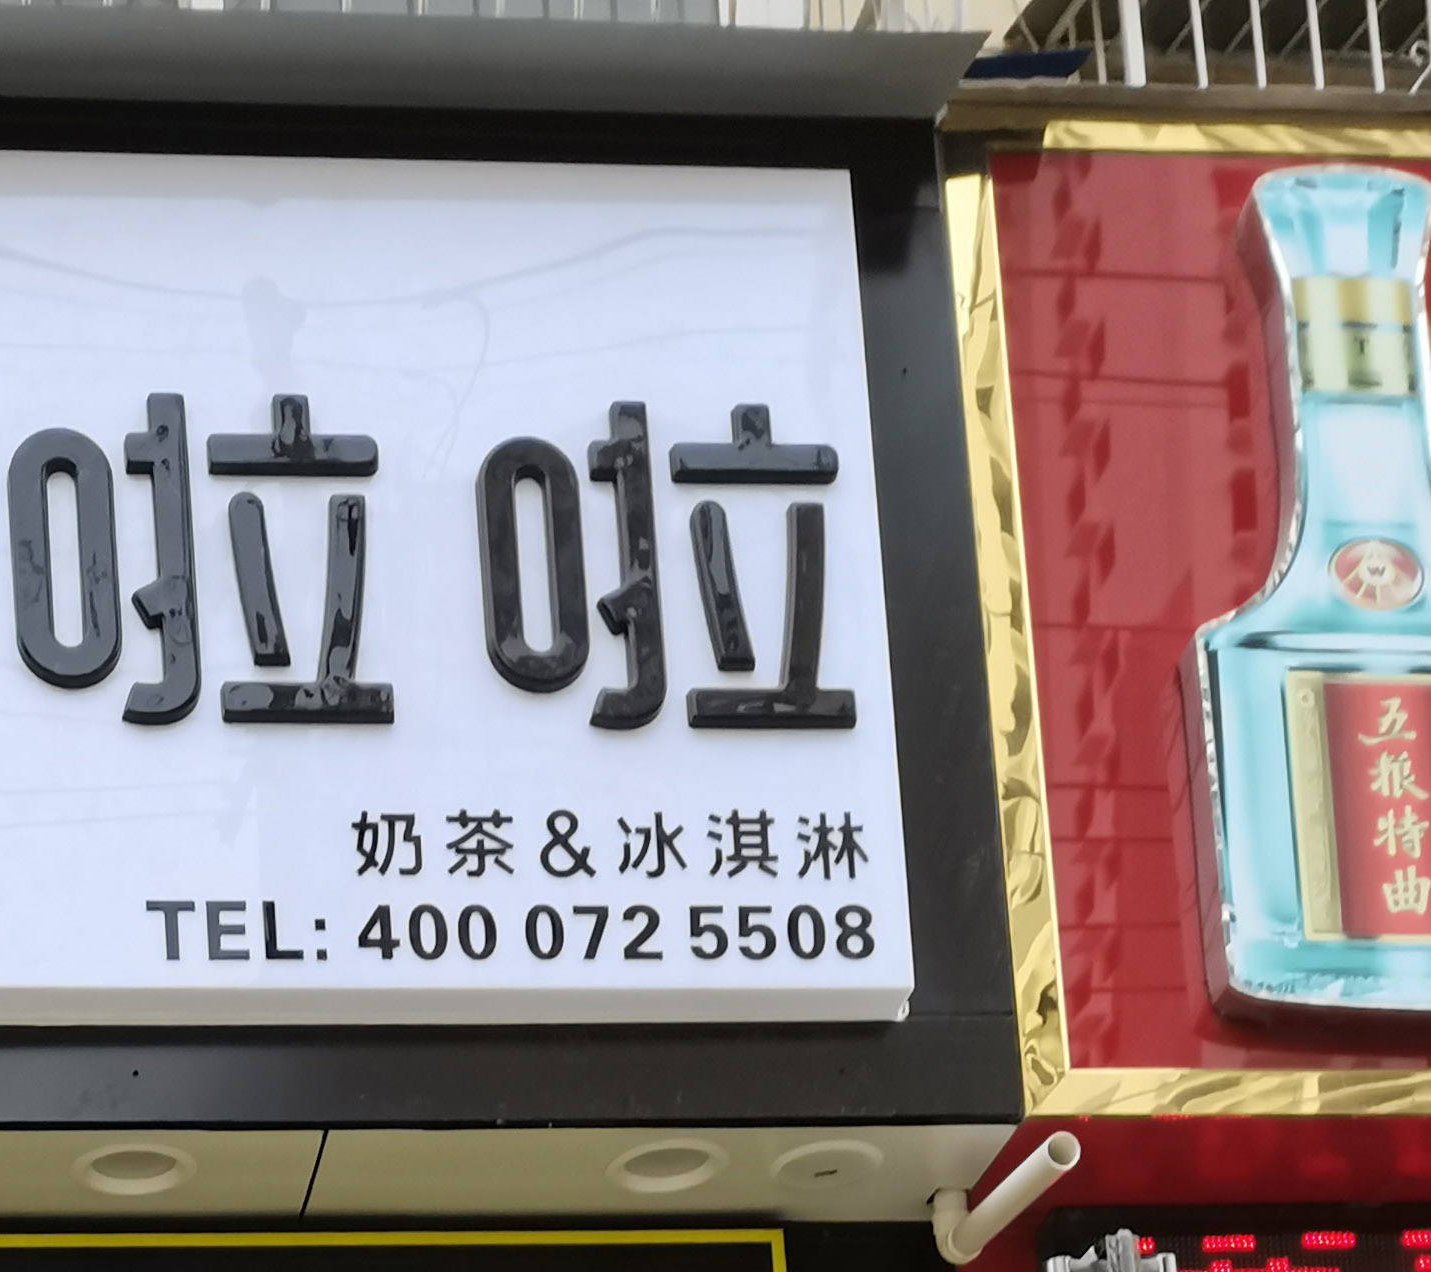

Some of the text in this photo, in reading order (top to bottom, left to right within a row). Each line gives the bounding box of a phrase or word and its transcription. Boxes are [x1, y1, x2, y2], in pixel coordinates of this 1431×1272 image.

[1358, 697, 1431, 915] 五粮特曲
[351, 808, 870, 881] 奶茶&冰淇淋
[145, 899, 876, 962] TEL: 400 072 5508
